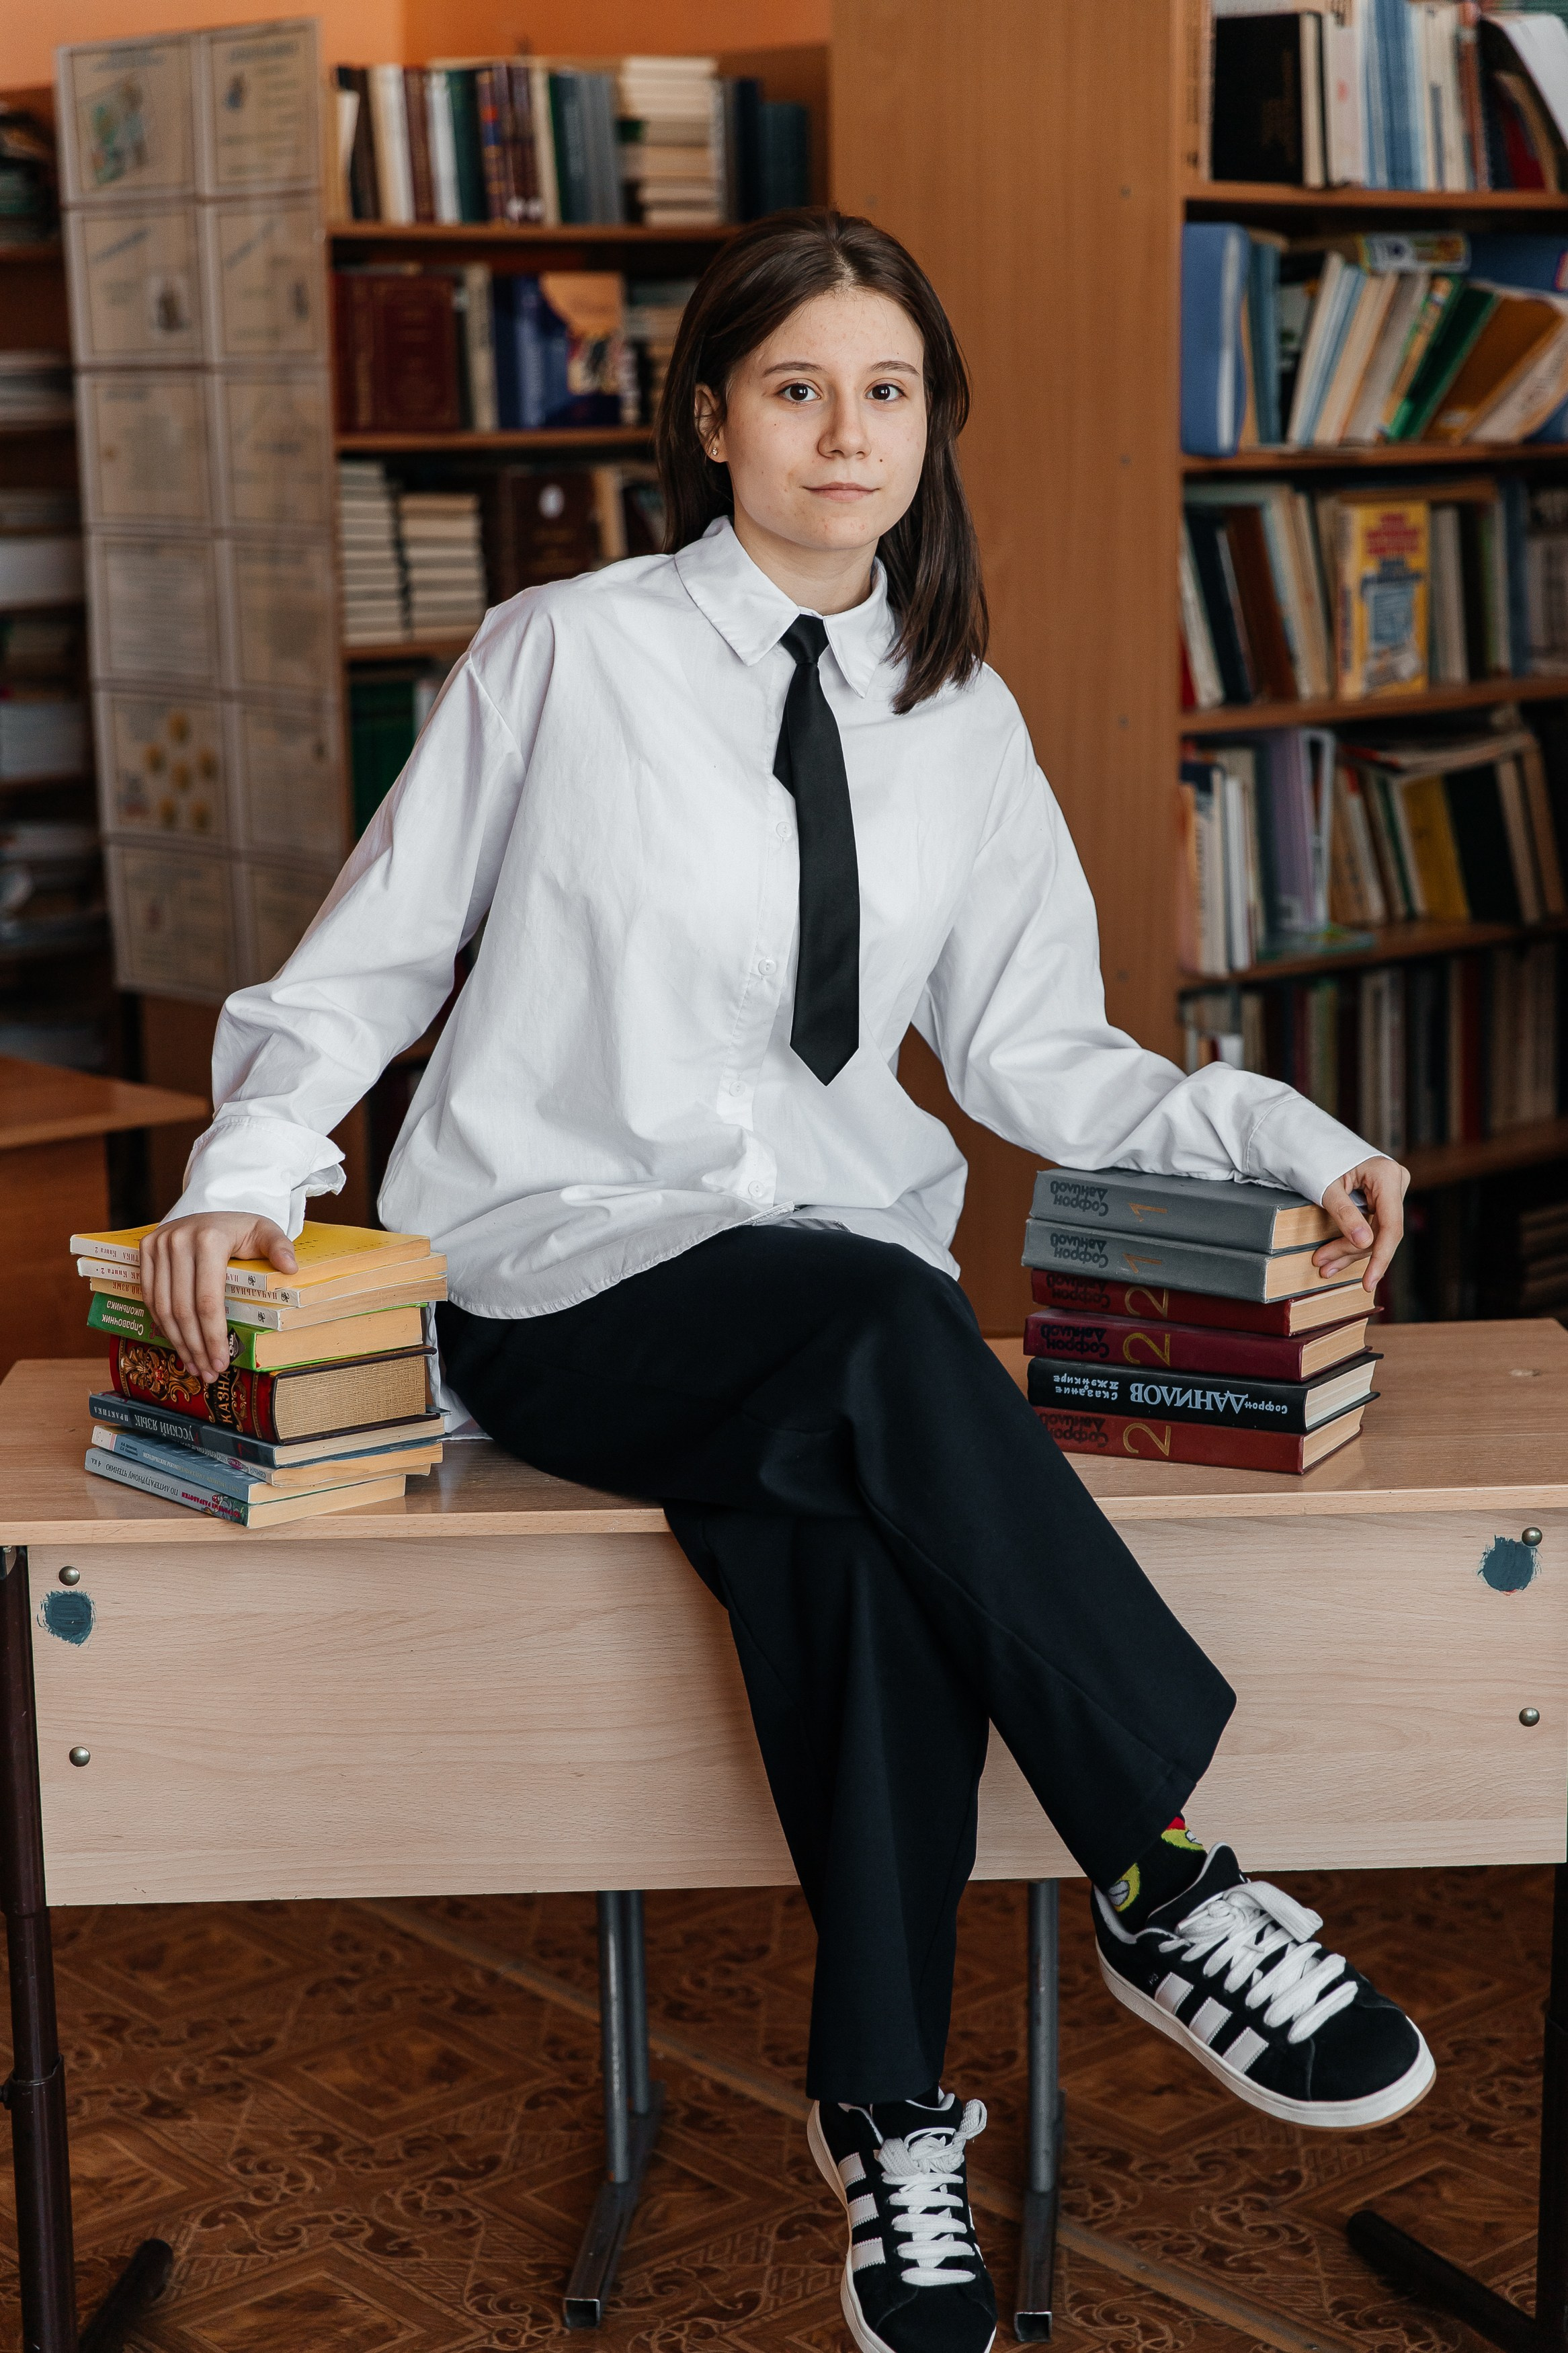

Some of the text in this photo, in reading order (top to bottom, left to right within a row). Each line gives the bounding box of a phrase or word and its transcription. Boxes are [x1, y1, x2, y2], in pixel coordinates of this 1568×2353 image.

[1050, 1181, 1108, 1200] Данилов
[1054, 1194, 1108, 1217] Софрон
[1128, 1202, 1167, 1222] 1
[1050, 1233, 1107, 1252] Данилов
[100, 1248, 117, 1257] Книга
[1054, 1246, 1108, 1269] Софрон
[1123, 1252, 1162, 1273] 1
[108, 1267, 128, 1278] Книга
[113, 1281, 130, 1291] ЯЗЫК
[231, 1285, 278, 1300] НАЧАЛЬНАЯ
[107, 1300, 144, 1317] школьника
[1125, 1286, 1168, 1318] 2
[101, 1314, 144, 1335] Справочник
[1040, 1324, 1106, 1342] Данилов
[1046, 1334, 1109, 1358] Софрон
[1123, 1333, 1170, 1366] 2
[220, 1370, 231, 1423] КАЗНА
[1055, 1386, 1117, 1400] Сказание
[1130, 1384, 1287, 1414] Софрон ДАНИЛОВ
[94, 1406, 128, 1421] ПРАКТИКА
[134, 1414, 157, 1431] ЯЗЫК
[1053, 1425, 1108, 1447] Софро
[1123, 1422, 1171, 1455] 2
[97, 1459, 101, 1468] 4
[106, 1464, 128, 1477] ЧТЕНИЮ
[128, 1474, 170, 1493] ЛИТЕРАТУРНОМУ
[170, 1486, 179, 1496] ПО
